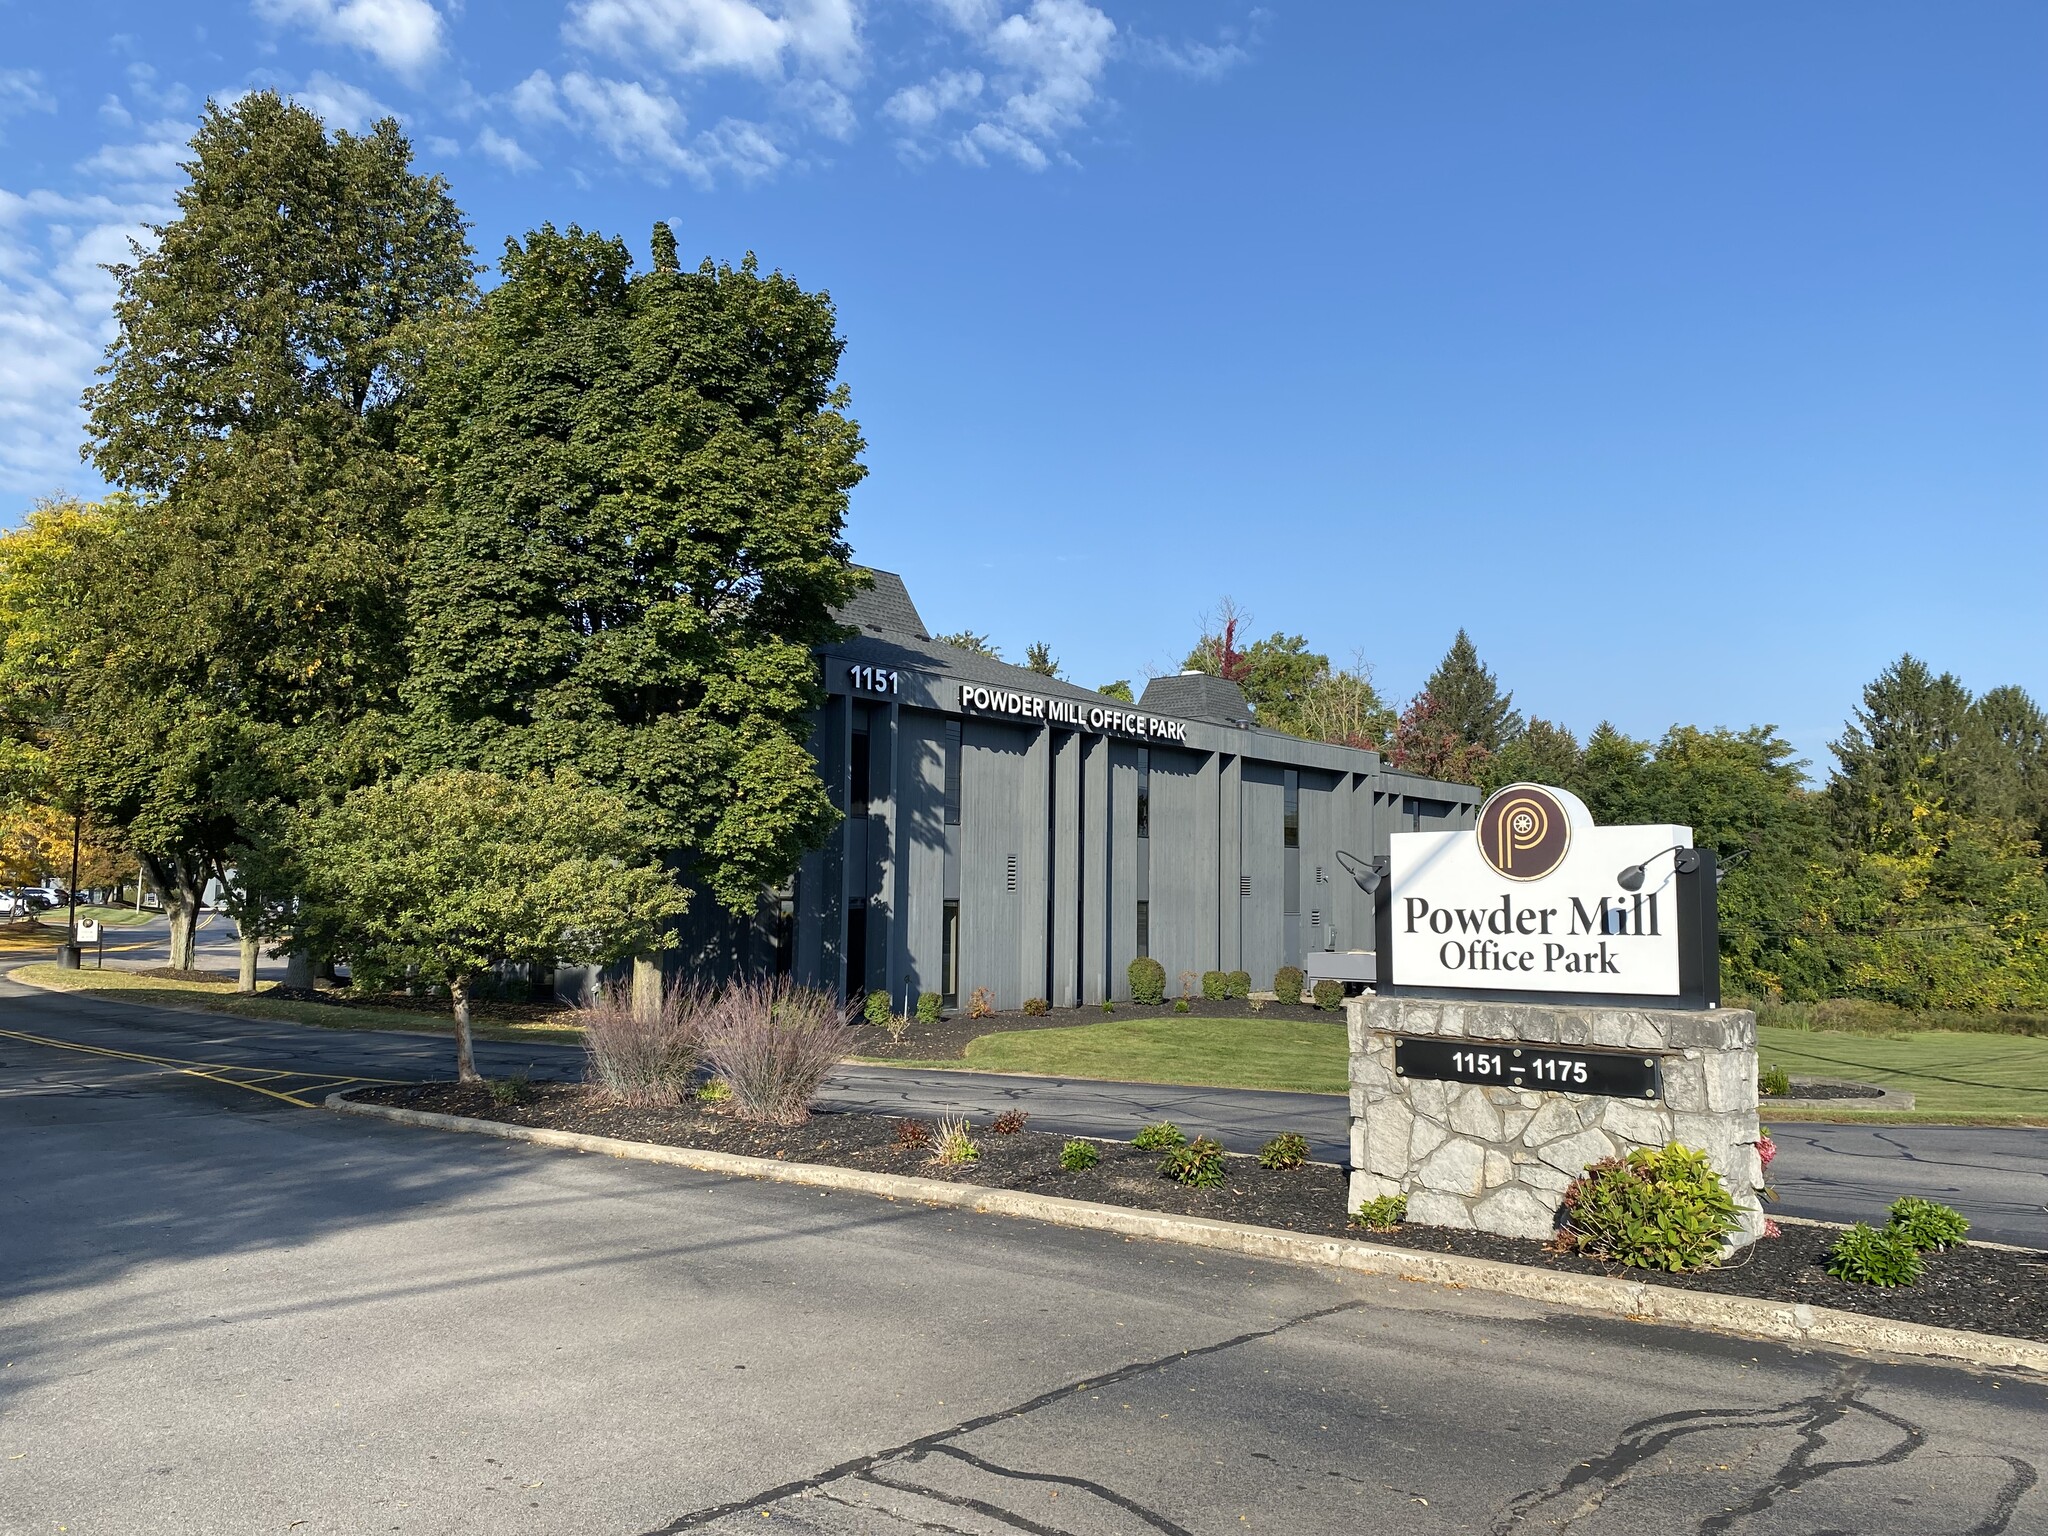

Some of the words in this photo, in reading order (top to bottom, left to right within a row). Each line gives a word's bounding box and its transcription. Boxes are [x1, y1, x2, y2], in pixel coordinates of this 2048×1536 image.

[850, 665, 898, 694] 1151
[962, 685, 1044, 719] POWDER
[1048, 700, 1087, 726] MILL
[1090, 708, 1146, 735] OFFICE
[1149, 718, 1186, 741] PARK
[1404, 894, 1557, 936] Powder
[1568, 894, 1662, 937] Mill
[1439, 940, 1534, 972] Office
[1543, 942, 1621, 975] Park
[1452, 1051, 1502, 1076] 1151
[1531, 1058, 1588, 1083] 1175
